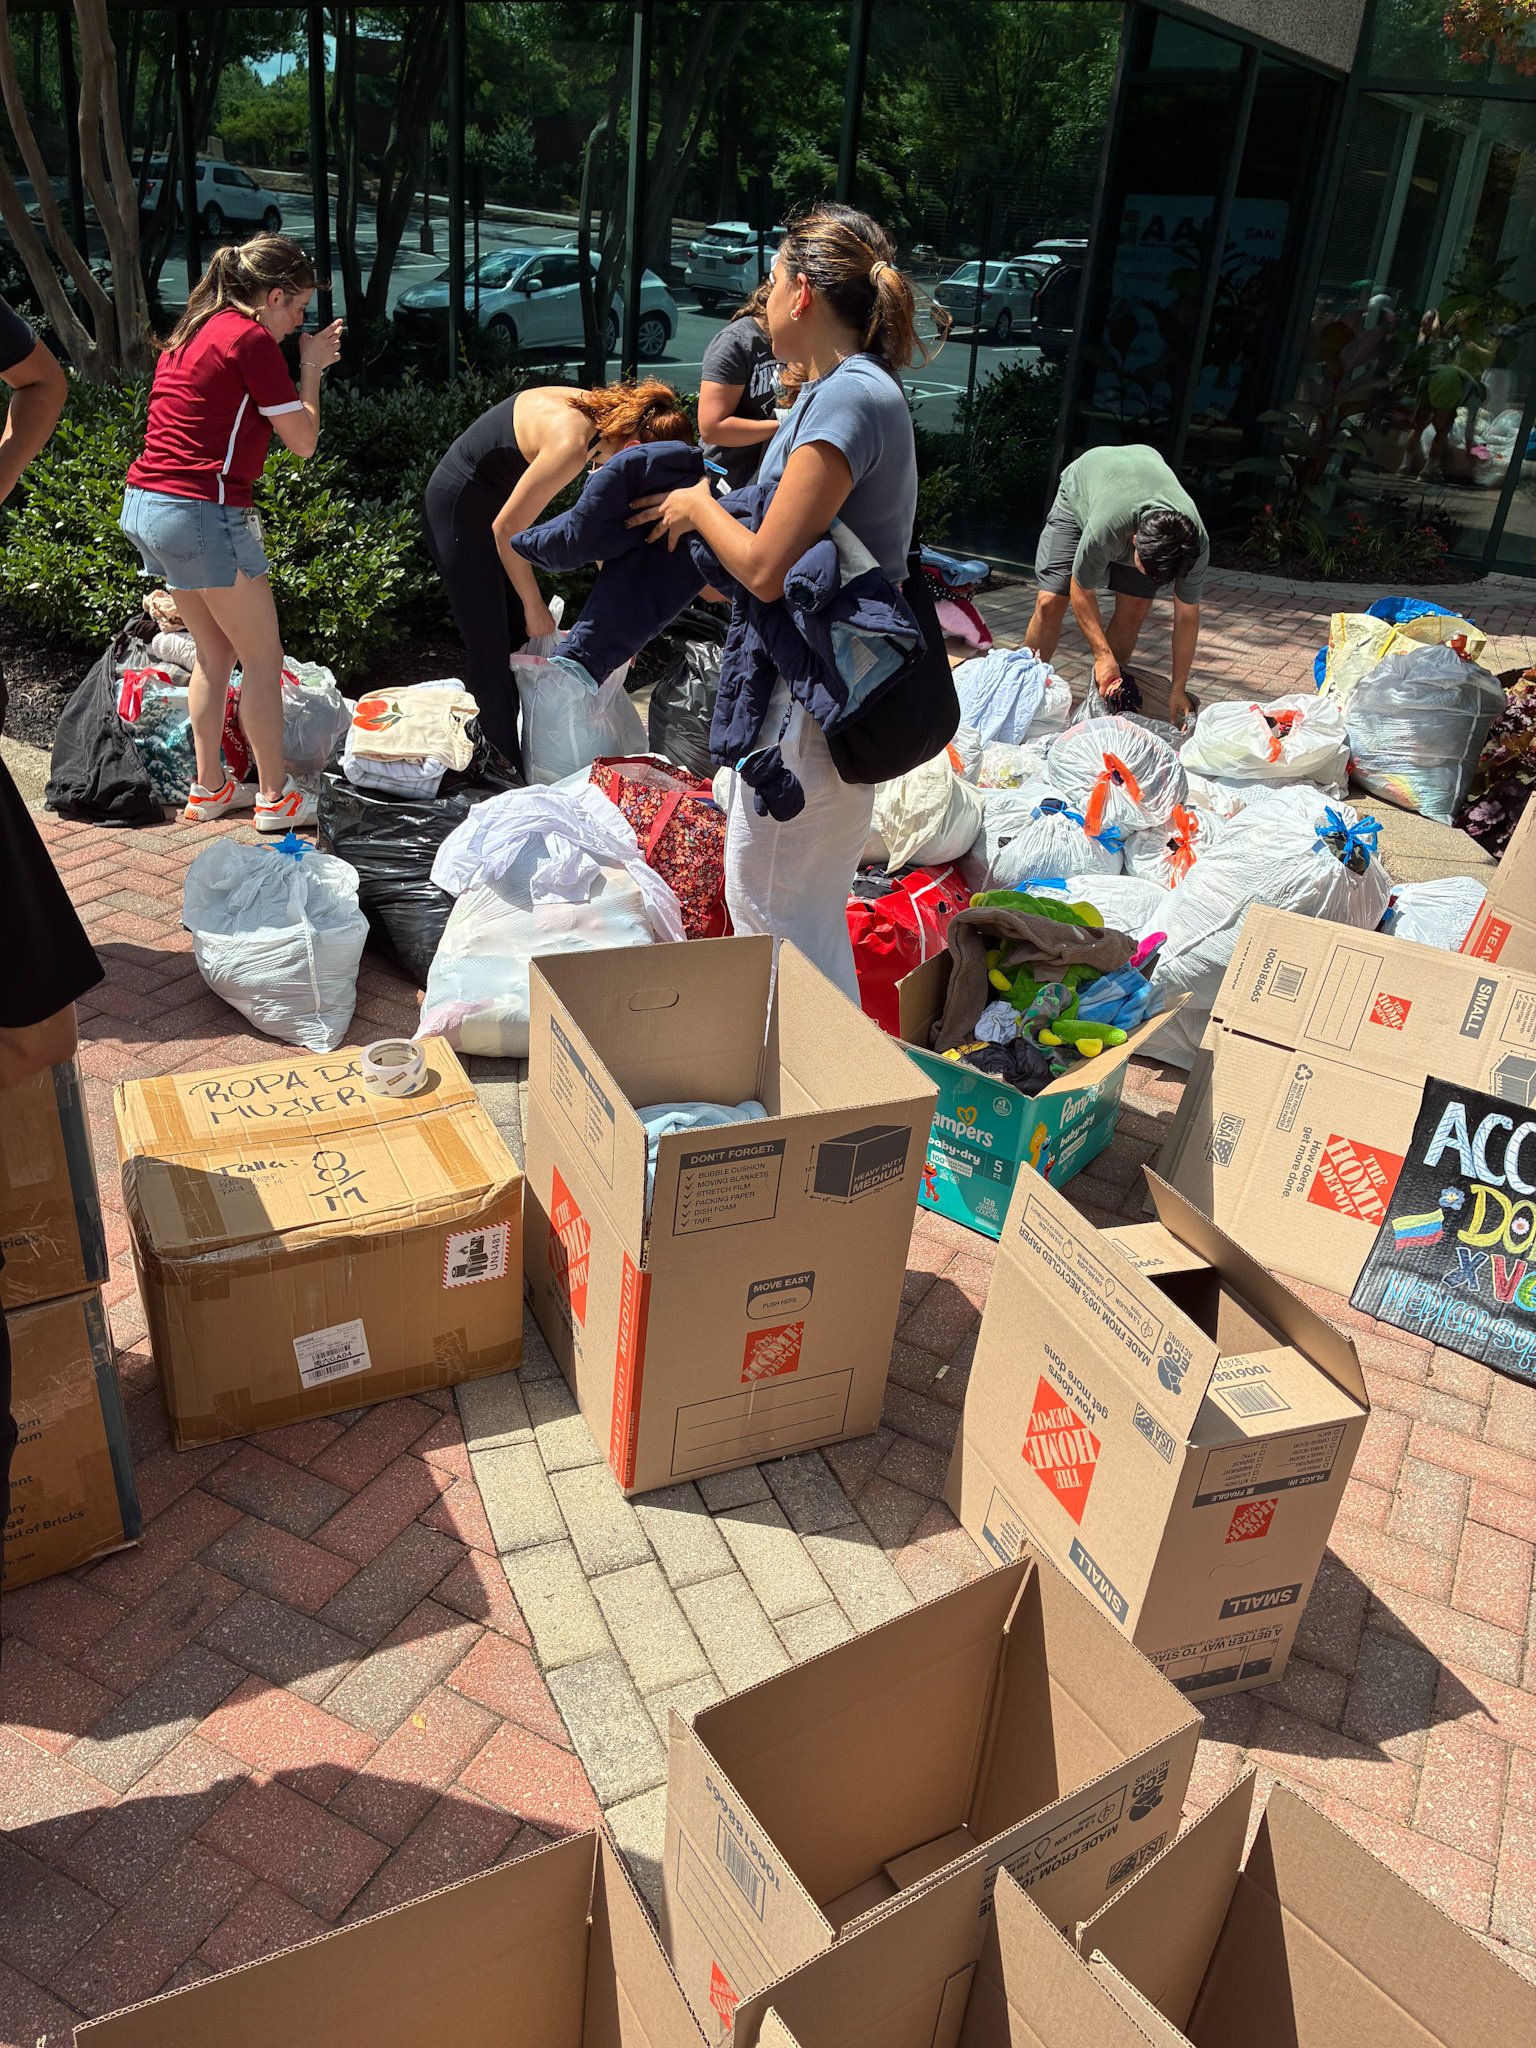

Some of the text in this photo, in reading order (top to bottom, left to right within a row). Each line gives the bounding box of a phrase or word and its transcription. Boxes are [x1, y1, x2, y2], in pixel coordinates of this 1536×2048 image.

[1465, 983, 1493, 1031] SMALL
[189, 1070, 310, 1103] ROPA
[209, 1086, 368, 1125] MUJER
[932, 1112, 994, 1149] ampers
[1217, 1115, 1237, 1142] USA
[1301, 1126, 1313, 1145] get
[690, 1144, 775, 1165] DON'T FORGET:
[993, 1159, 1004, 1173] 5
[1290, 1146, 1306, 1171] more
[1296, 1140, 1323, 1193] How doers
[697, 1171, 769, 1188] MOVING BLANKETS
[698, 1163, 766, 1179] BUBBLE CUSHION
[852, 1163, 904, 1194] MEDIUM
[854, 1156, 903, 1183] HEAVY DUTY
[1326, 1137, 1386, 1224] HOME
[1362, 1153, 1389, 1188] THE
[695, 1183, 751, 1198] STRETCH FILM
[695, 1191, 755, 1207] PACKING PAPER
[1318, 1163, 1357, 1214] DEPOT
[554, 1199, 572, 1228] THE
[693, 1216, 713, 1225] TAPE
[714, 1203, 737, 1213] FOAM
[1457, 1184, 1536, 1261] DO
[489, 1233, 501, 1271] UN3481
[1018, 1225, 1043, 1254] PAPER
[753, 1274, 811, 1293] MOVE EASY
[1042, 1250, 1082, 1295] RECYCLED
[1442, 1247, 1490, 1292] X
[619, 1262, 634, 1359] MEDIUM
[762, 1296, 798, 1309] PUSH HERE
[1082, 1290, 1101, 1315] 100%
[1101, 1311, 1126, 1341] FROM
[742, 1322, 804, 1381] HOME
[1125, 1337, 1151, 1367] MADE
[1163, 1341, 1191, 1373] ECO
[1167, 1331, 1194, 1360] ACTIONS
[616, 1364, 626, 1408] DUTY
[1044, 1343, 1109, 1420] get more done
[1048, 1363, 1096, 1425] How doers
[1031, 1406, 1075, 1433] DEPOT
[1025, 1427, 1098, 1471] HOME
[1155, 1423, 1174, 1452] USA
[1053, 1468, 1083, 1489] THE
[1299, 1474, 1326, 1484] PLACE
[1211, 1489, 1246, 1502] FRAGILE
[26, 1509, 86, 1535] of Bricks
[1226, 1500, 1276, 1544] HOME
[1077, 1547, 1122, 1613] SMALL
[1229, 1588, 1294, 1614] SMALL
[1228, 1628, 1269, 1646] BETTER
[1273, 1627, 1284, 1636] A
[1149, 1651, 1180, 1665] STAC
[1182, 1647, 1198, 1658] TO
[1199, 1639, 1226, 1654] WAY
[1131, 1768, 1170, 1799] ECO
[1134, 1758, 1171, 1786] ACTIONS
[704, 1775, 781, 1893] 1006188665
[1054, 1826, 1082, 1847] MILLION
[1081, 1823, 1119, 1851] MADE
[1038, 1849, 1080, 1882] FROM
